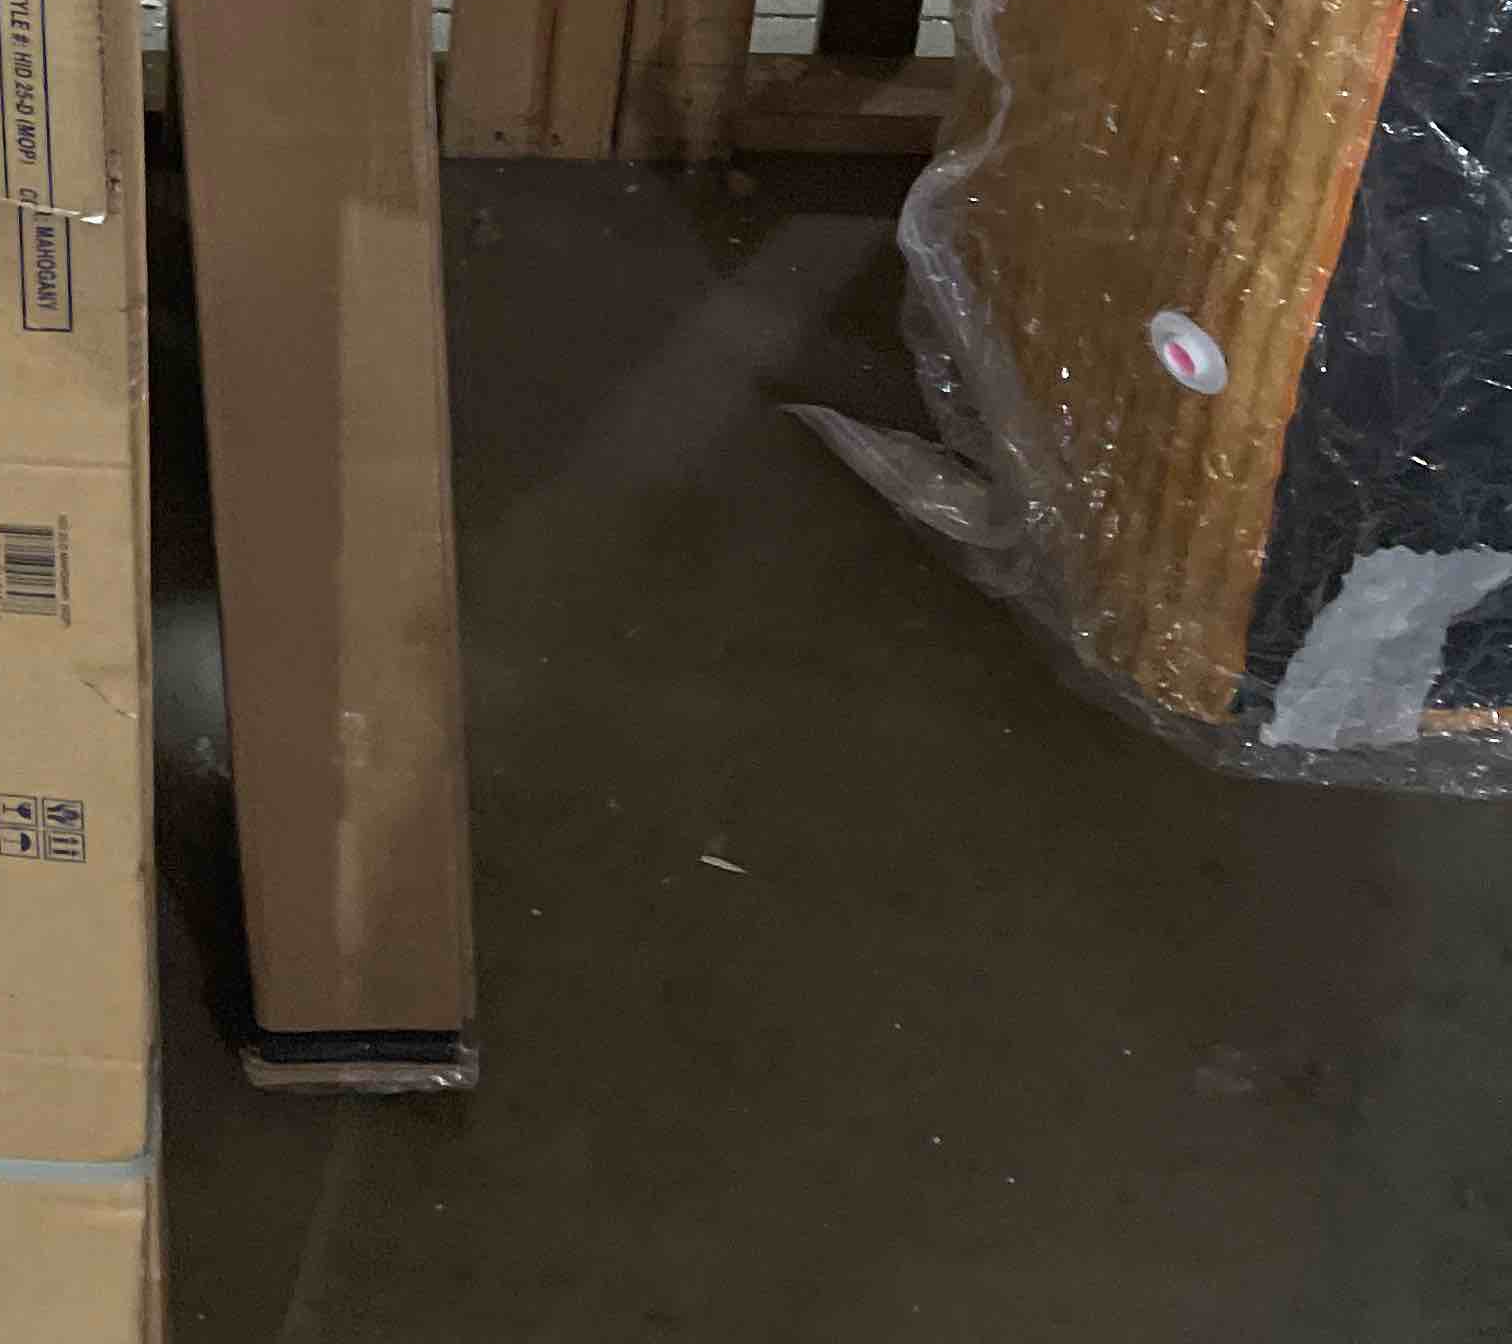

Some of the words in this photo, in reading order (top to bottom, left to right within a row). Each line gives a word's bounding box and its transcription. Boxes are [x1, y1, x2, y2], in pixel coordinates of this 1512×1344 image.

[15, 52, 34, 79] HID
[15, 83, 35, 115] 25-D
[36, 226, 58, 311] MAHOGANY
